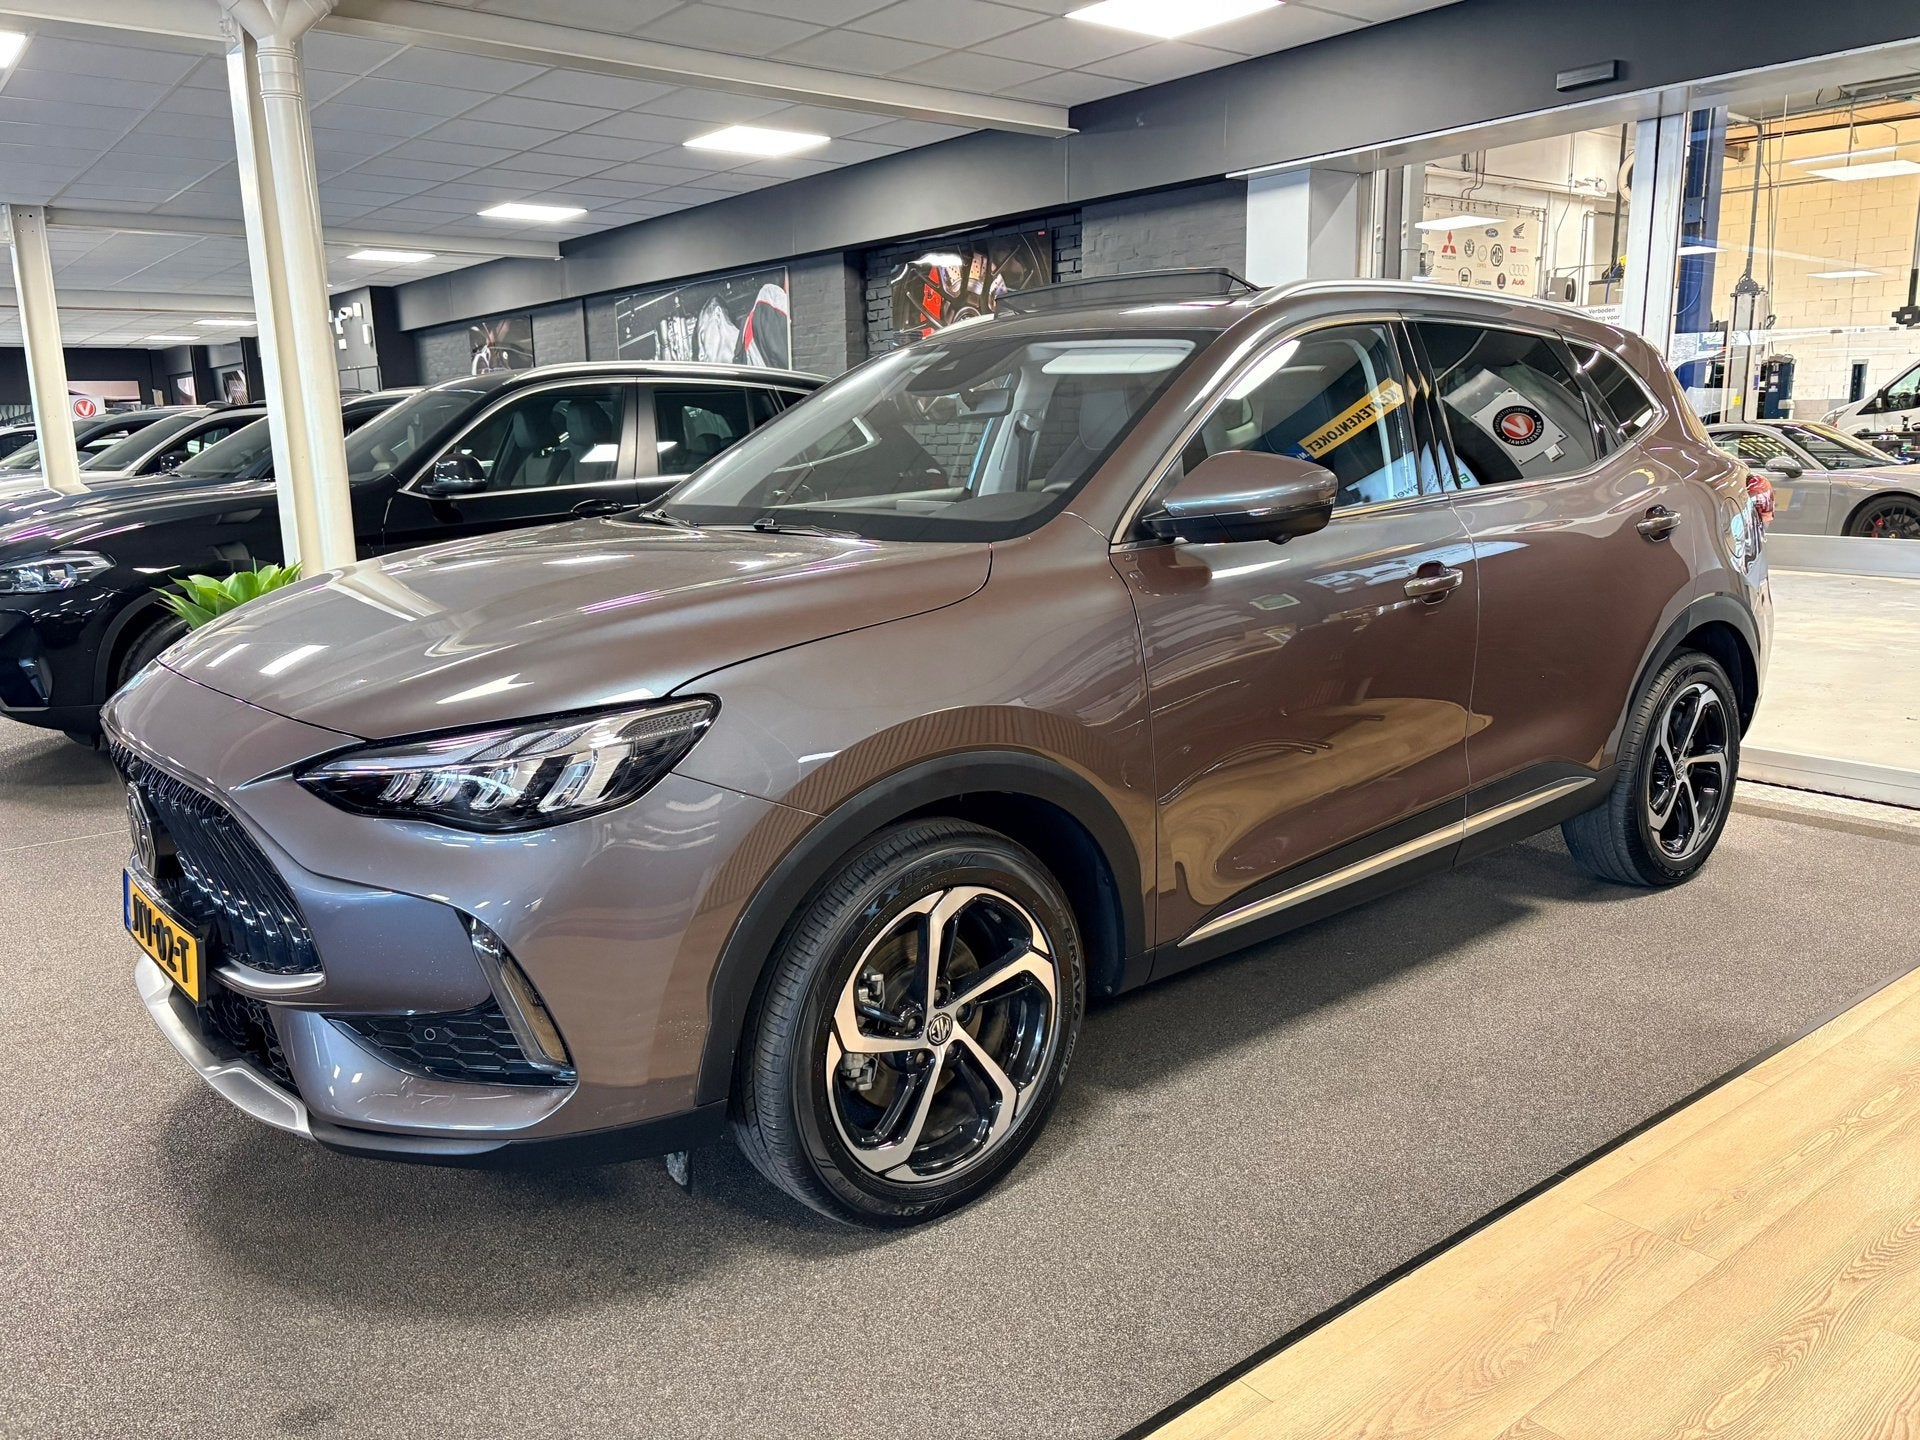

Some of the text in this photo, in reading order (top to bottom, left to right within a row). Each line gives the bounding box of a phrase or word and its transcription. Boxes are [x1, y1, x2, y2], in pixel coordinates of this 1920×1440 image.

[1491, 245, 1503, 266] MG
[1512, 278, 1525, 286] Audi
[929, 1014, 952, 1044] MG
